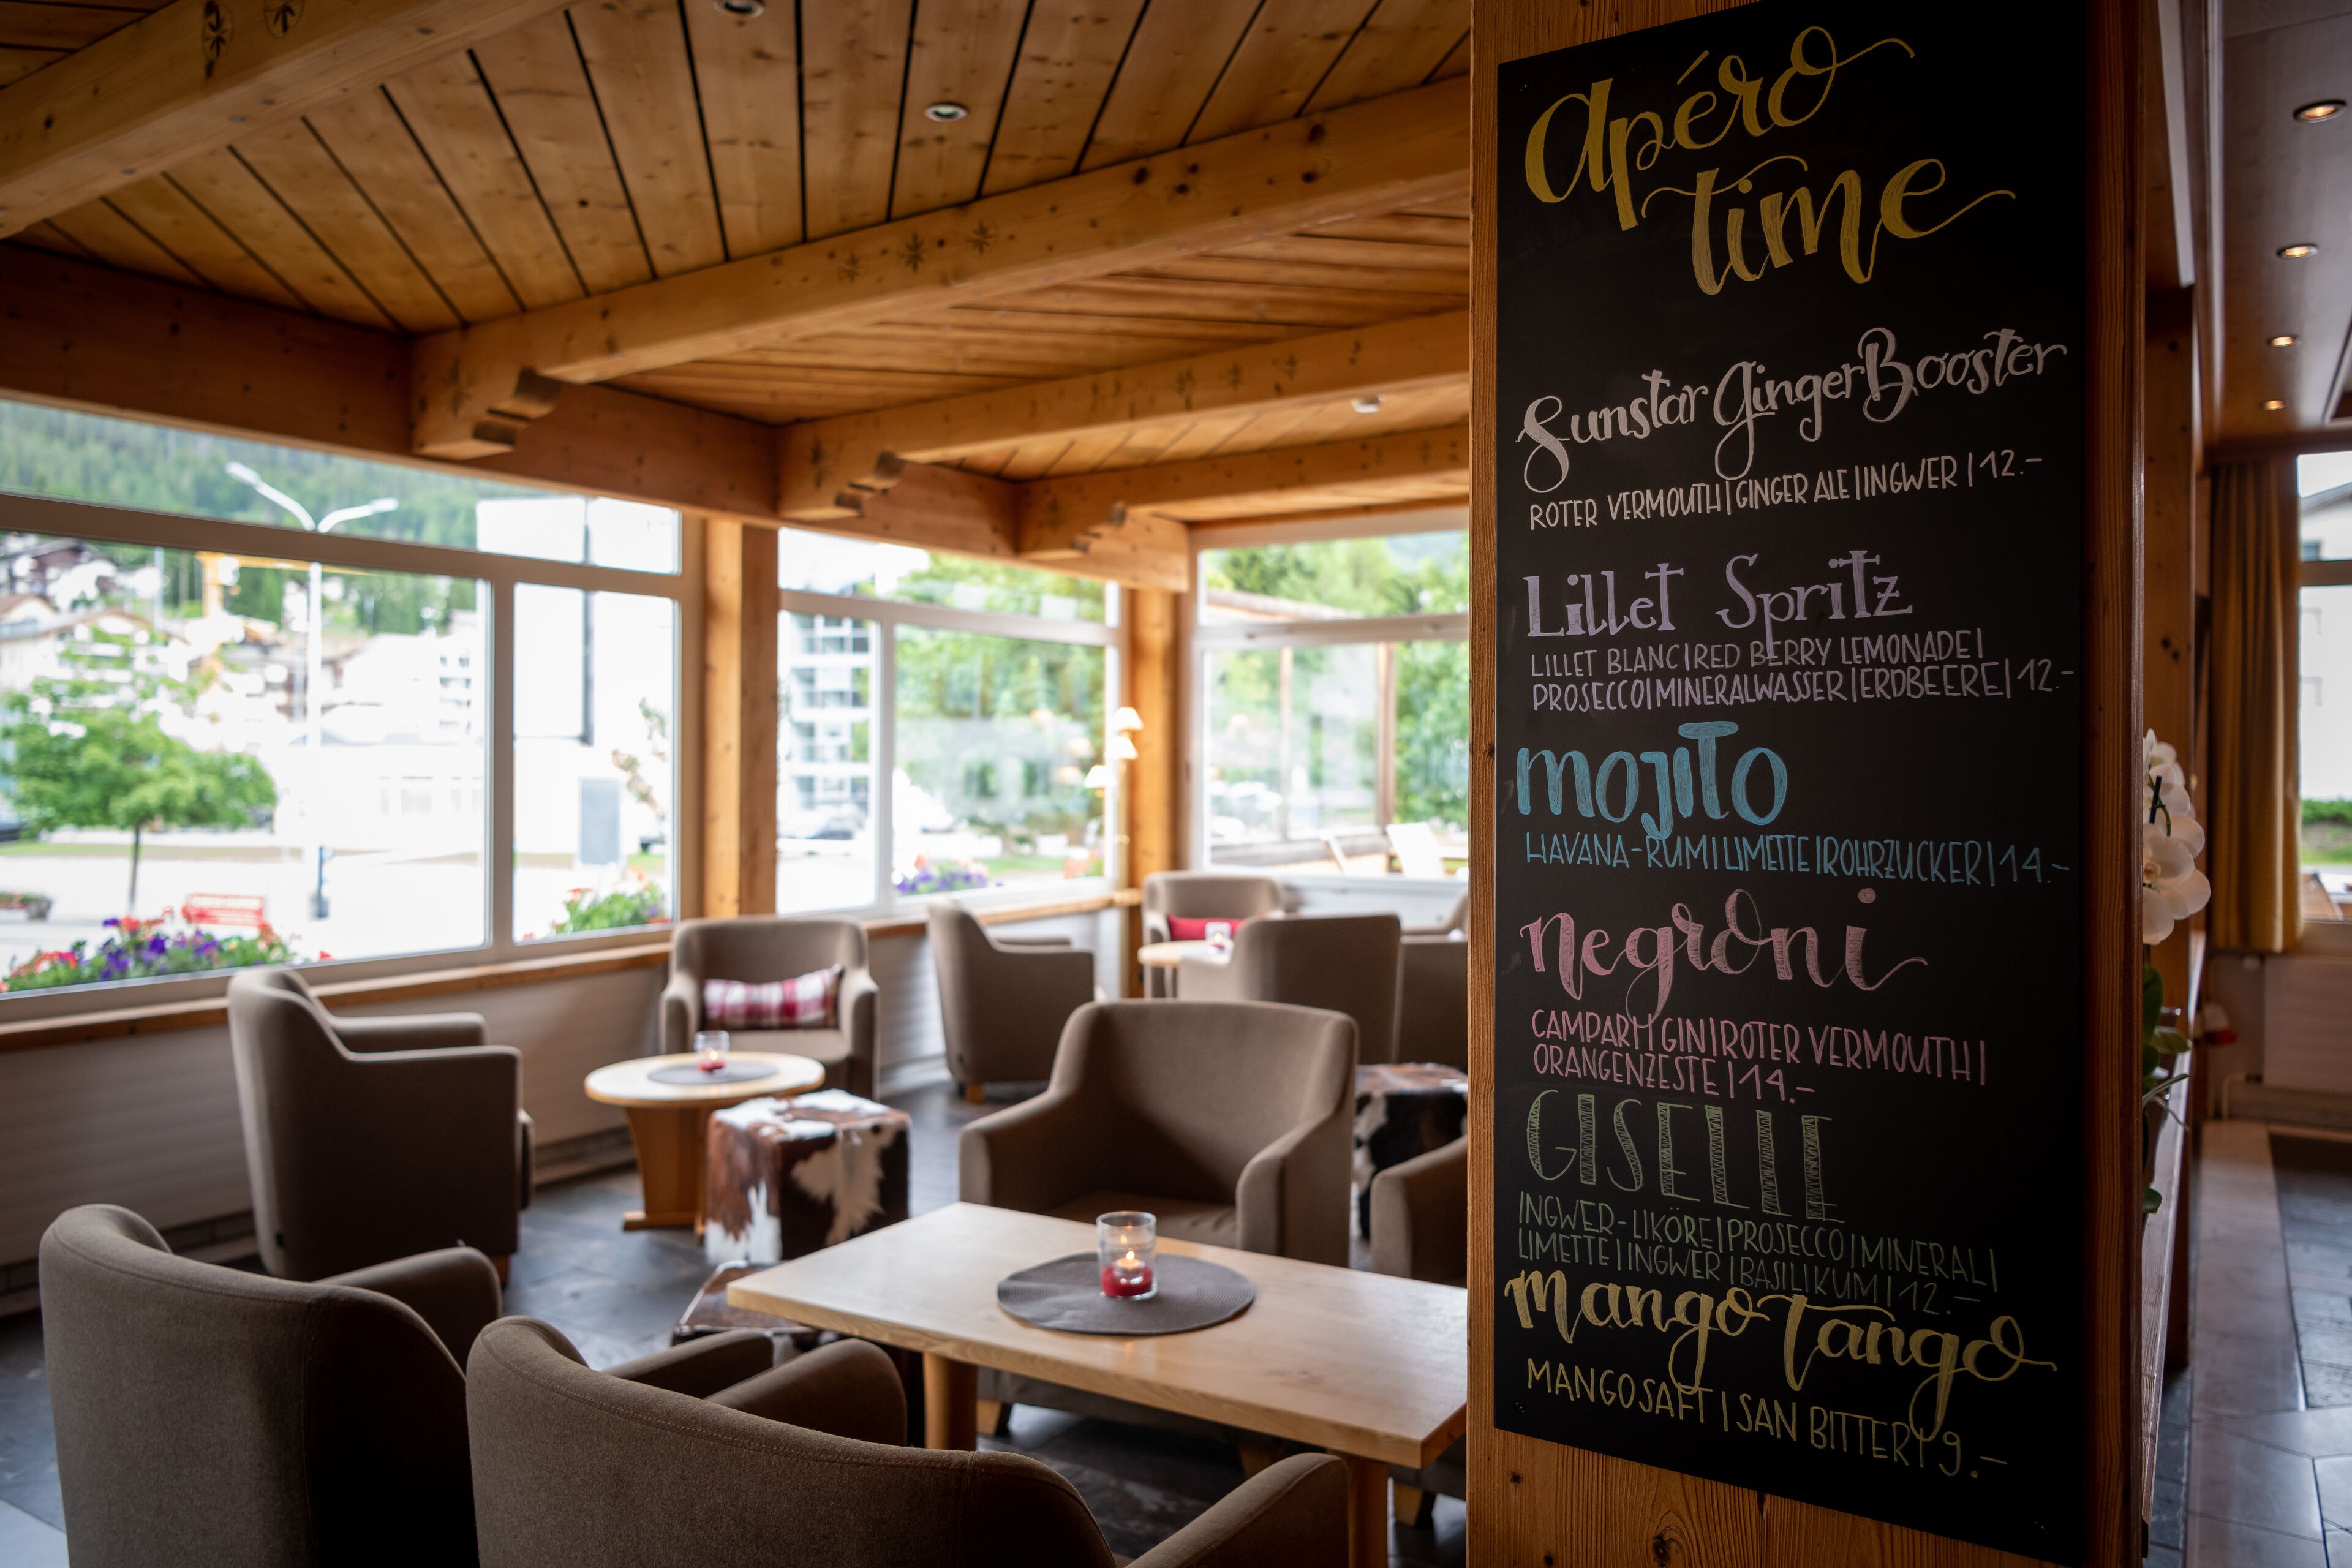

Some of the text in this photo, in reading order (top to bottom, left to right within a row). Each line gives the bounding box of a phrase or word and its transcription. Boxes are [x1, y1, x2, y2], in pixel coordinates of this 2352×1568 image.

[1516, 370, 1708, 492] Sunstar
[1504, 1268, 2057, 1442] Mango Tango
